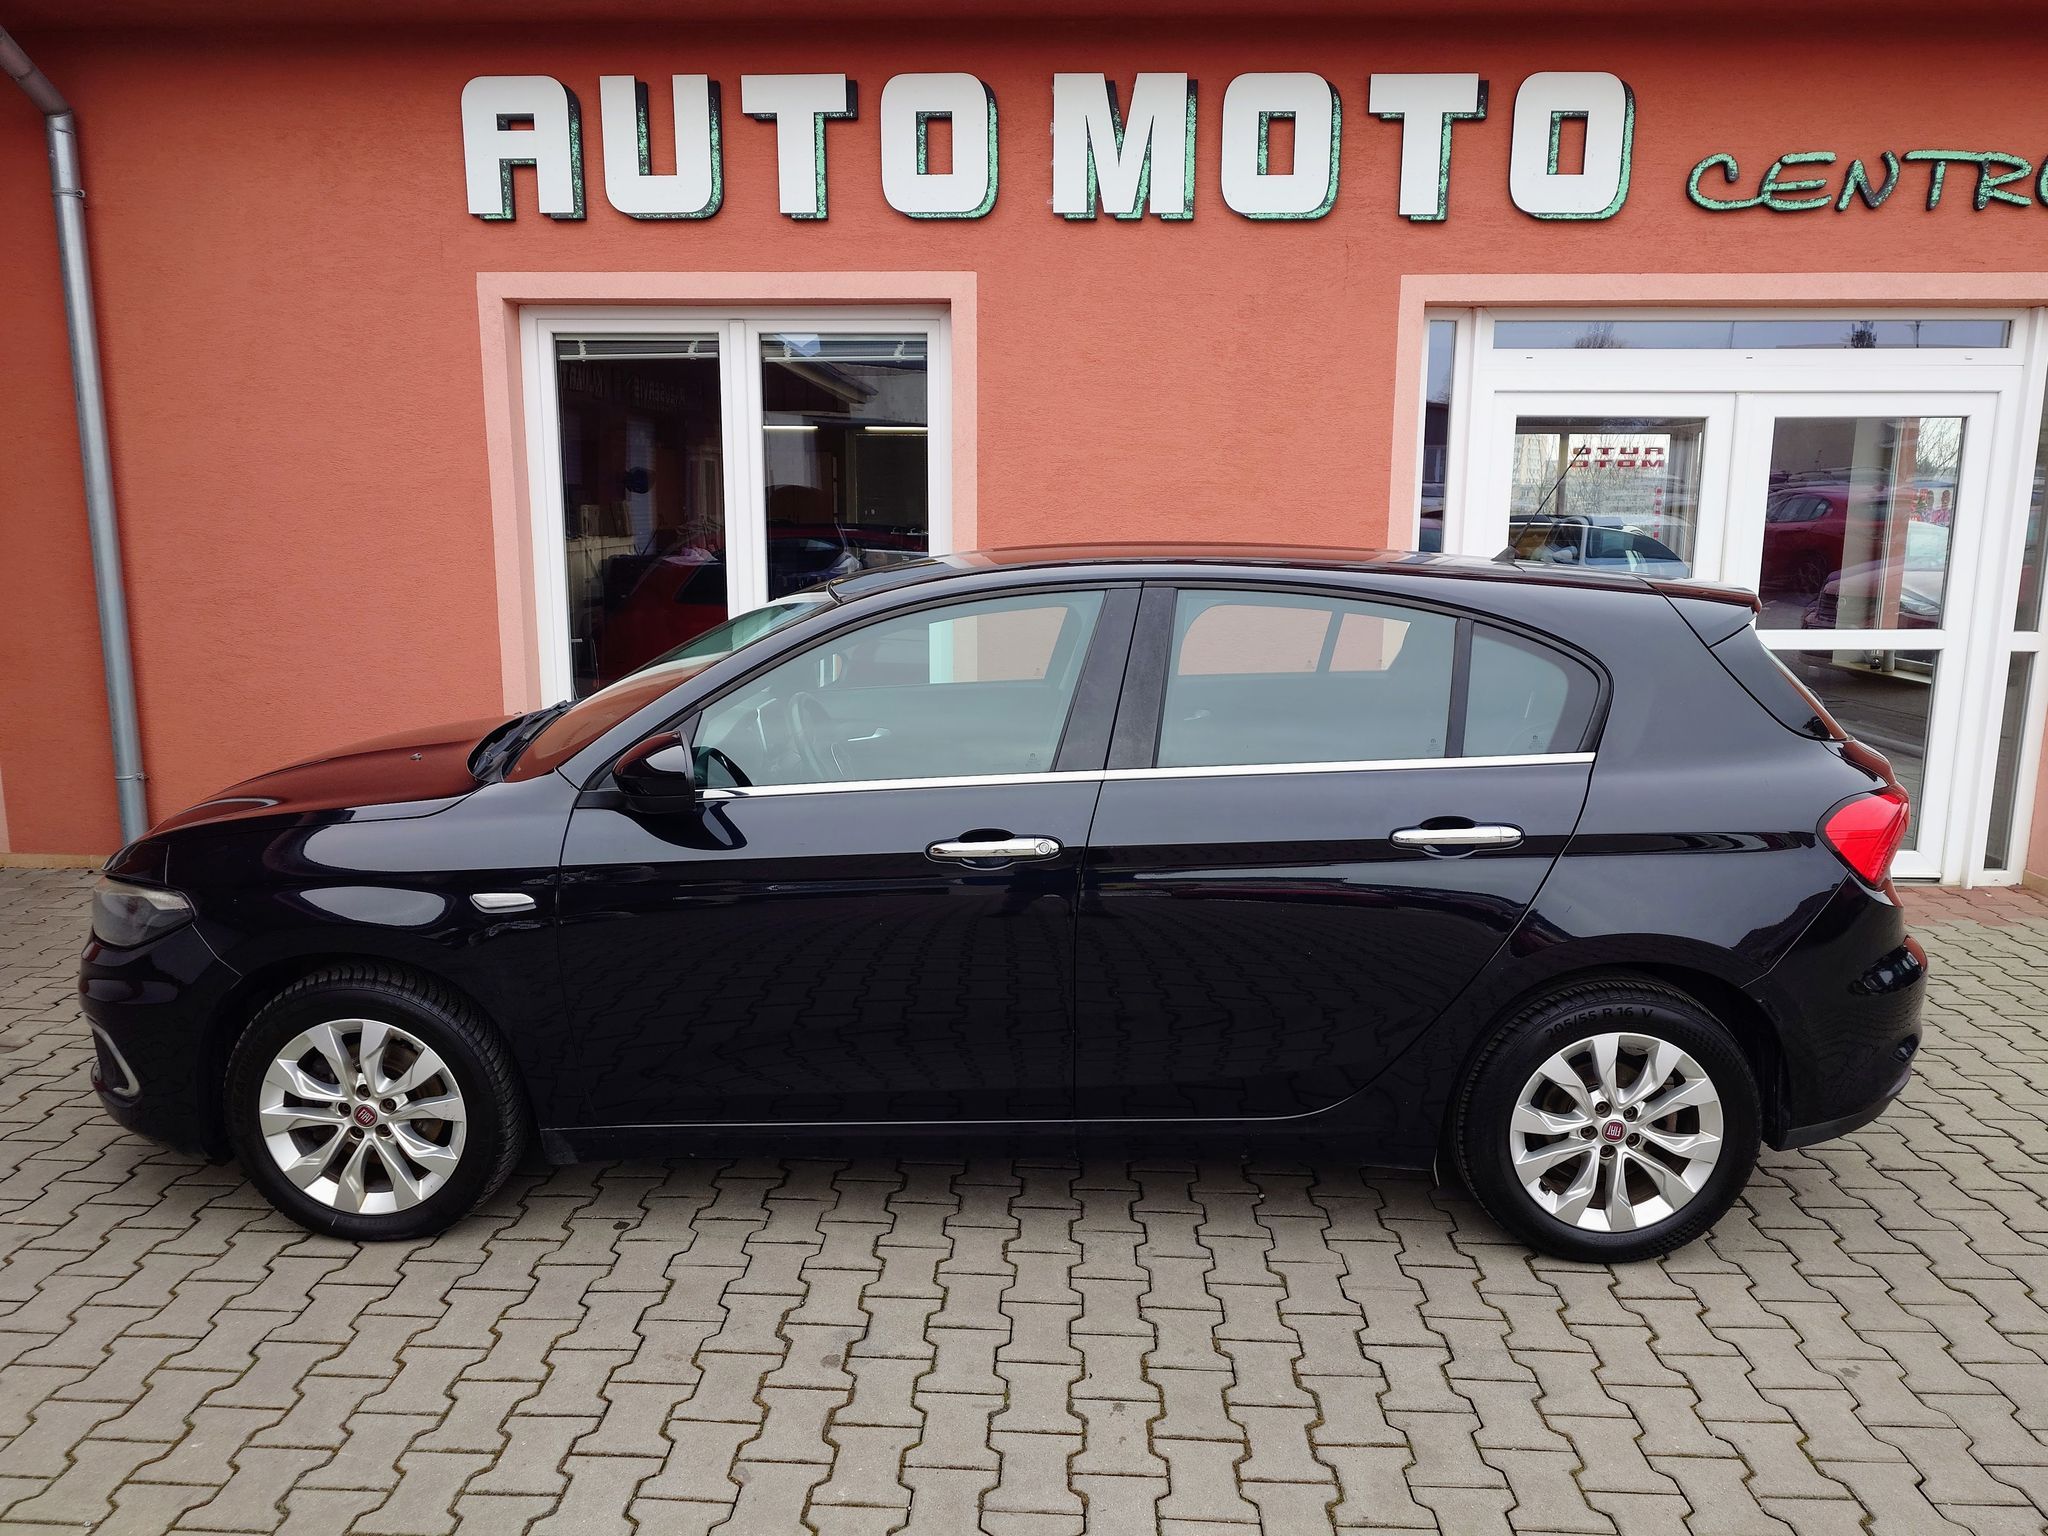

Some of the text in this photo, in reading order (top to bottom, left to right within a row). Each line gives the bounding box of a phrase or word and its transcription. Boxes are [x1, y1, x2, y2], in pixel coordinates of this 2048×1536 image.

[461, 71, 2048, 221] AUTO MOTO CENTR
[1545, 1009, 1597, 1035] 205/55
[357, 1109, 374, 1123] FIAT
[1606, 1125, 1621, 1137] FIAT
